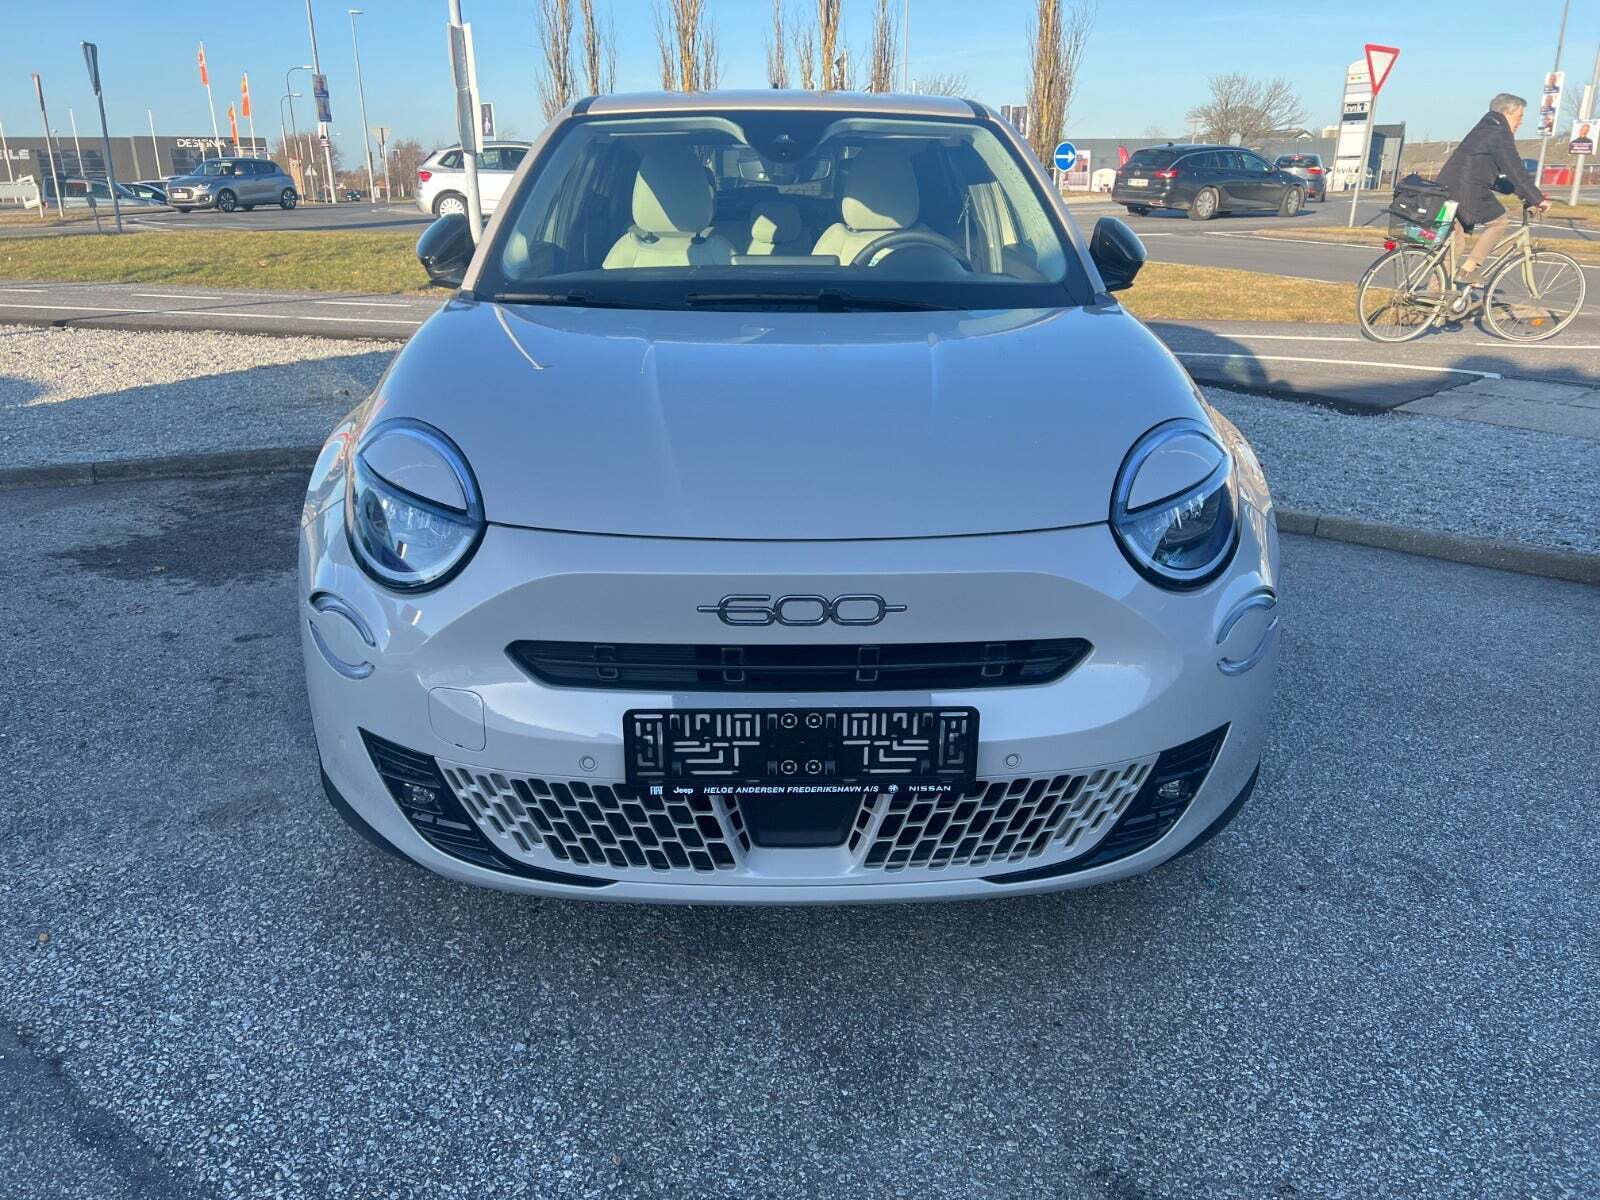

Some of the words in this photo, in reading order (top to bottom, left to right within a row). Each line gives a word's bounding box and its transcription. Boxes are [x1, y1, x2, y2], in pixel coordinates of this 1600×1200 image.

[717, 593, 887, 627] 600
[649, 785, 663, 795] FIAT
[673, 786, 694, 795] Jeep
[703, 786, 734, 794] HELGE
[735, 786, 785, 794] ANDERSEN
[787, 786, 862, 794] FREDERIKSHAVN
[863, 785, 879, 793] A/S
